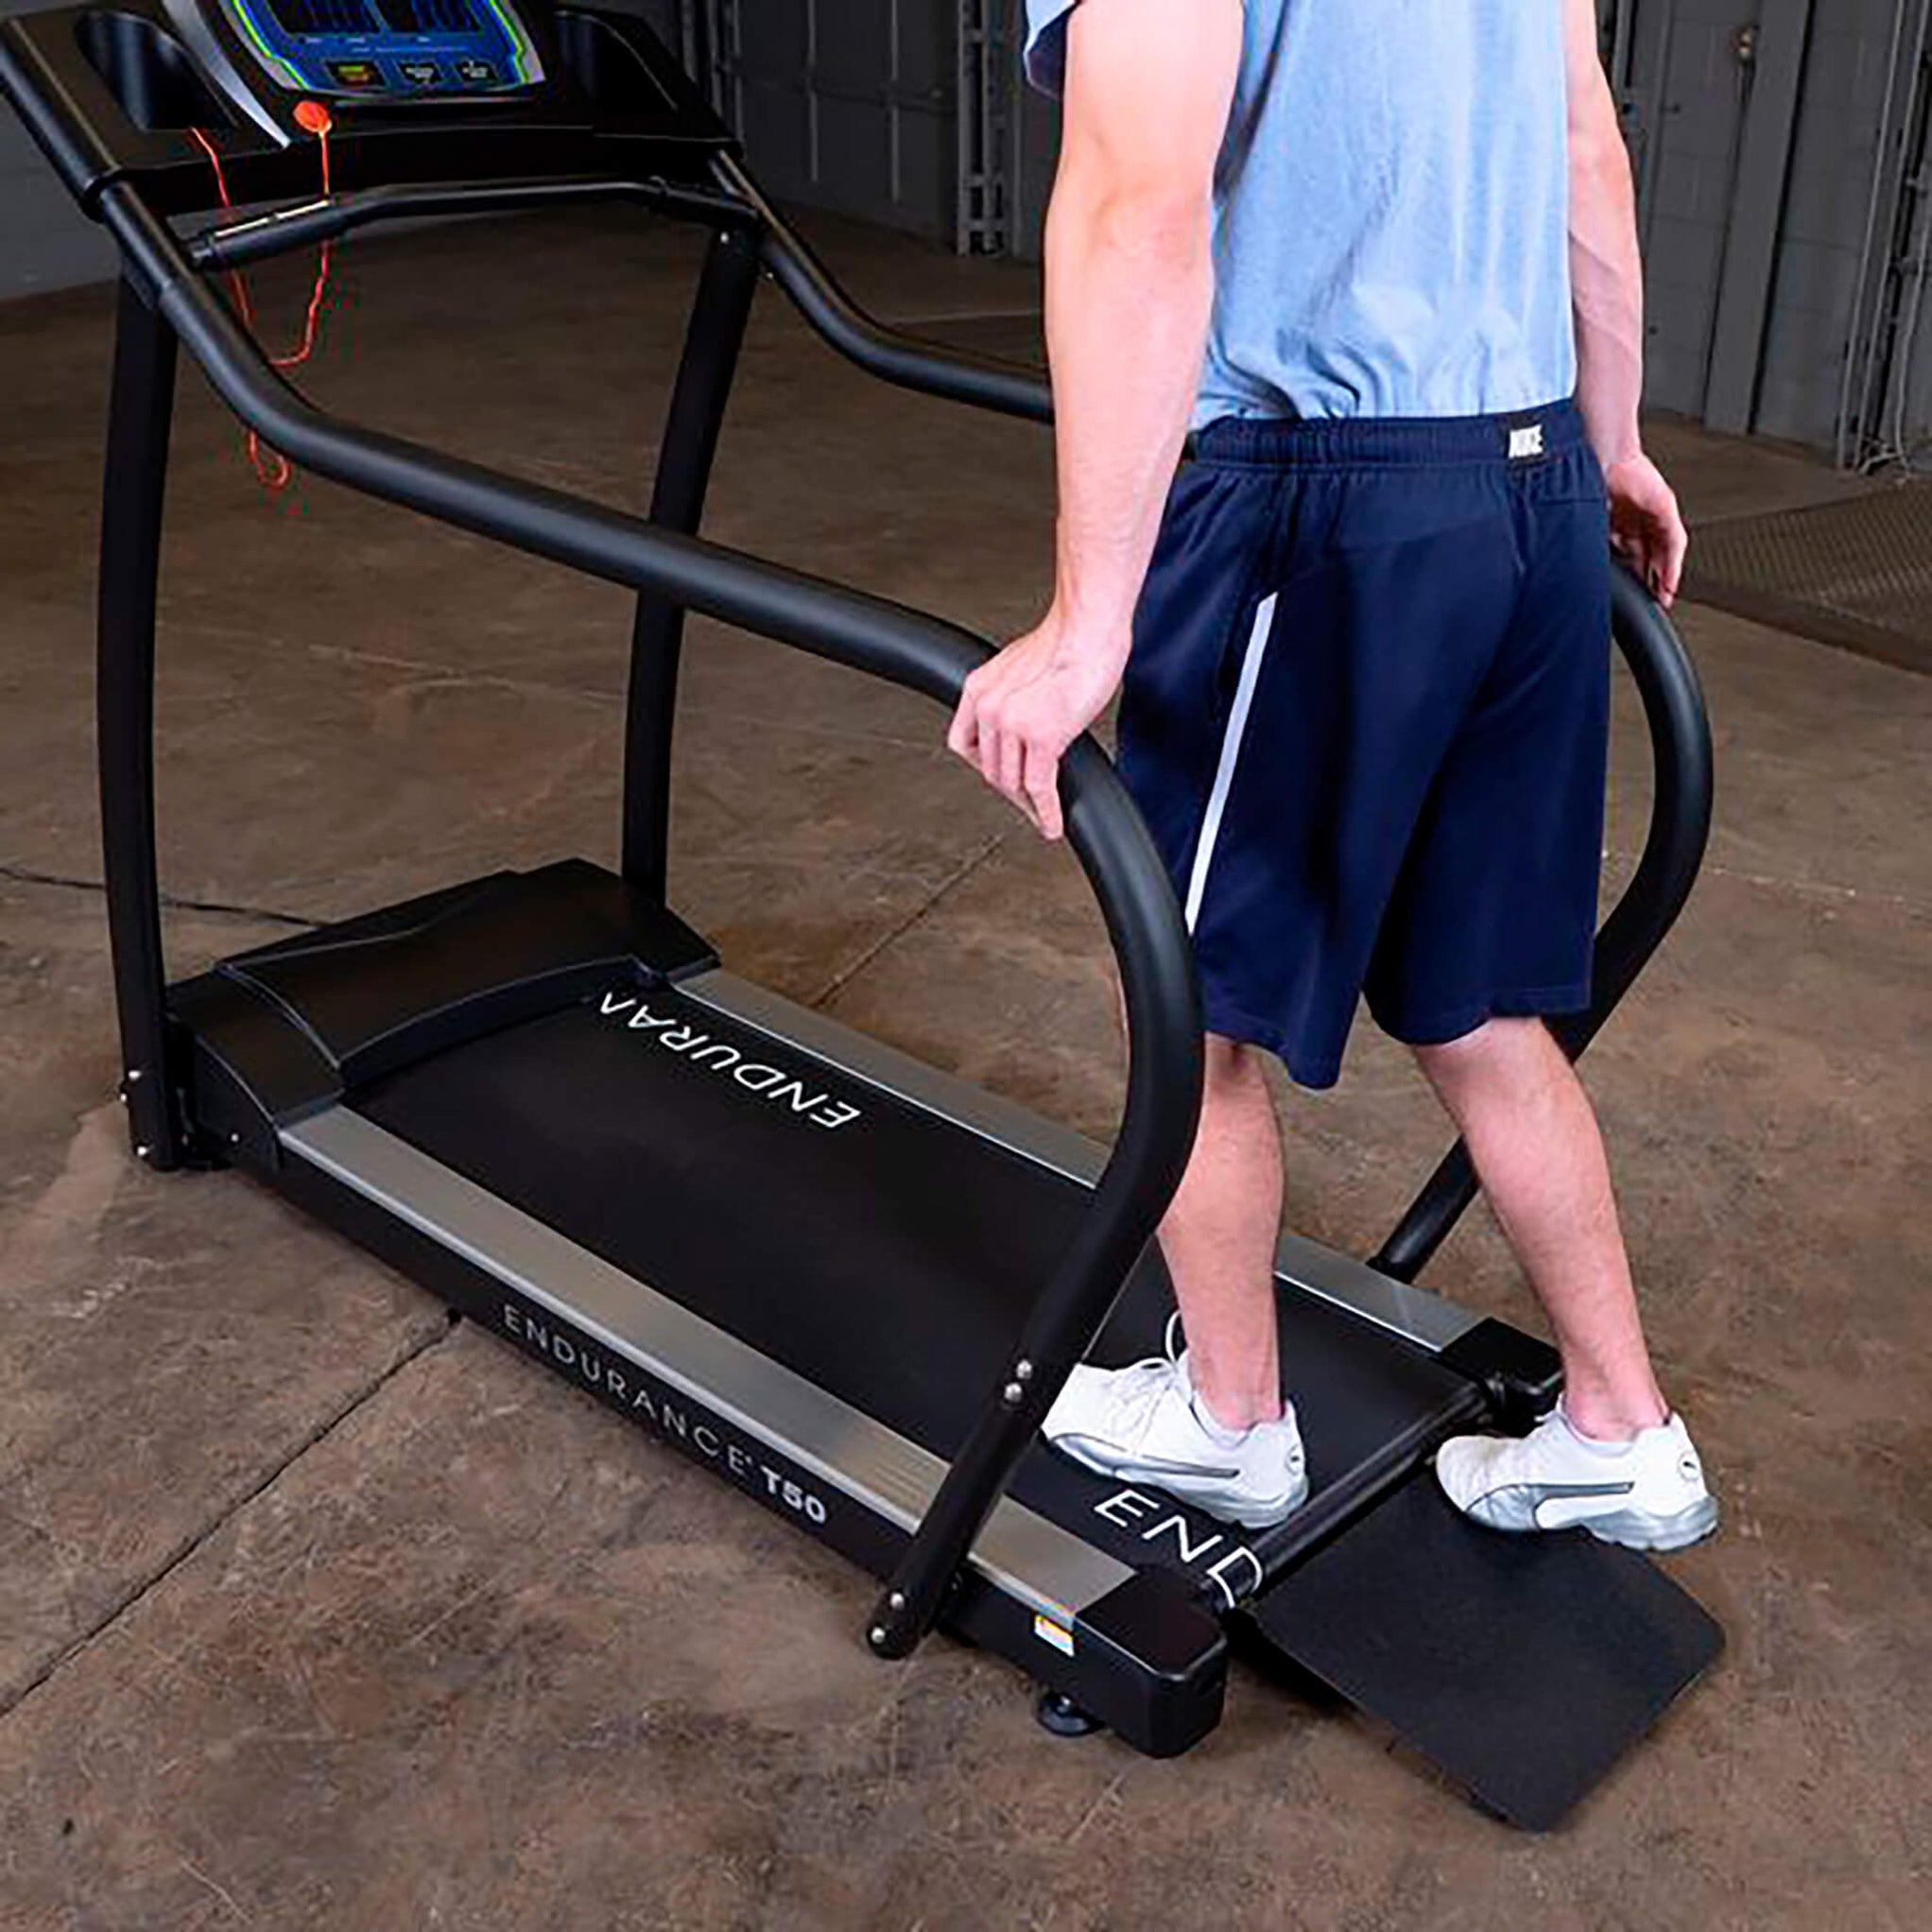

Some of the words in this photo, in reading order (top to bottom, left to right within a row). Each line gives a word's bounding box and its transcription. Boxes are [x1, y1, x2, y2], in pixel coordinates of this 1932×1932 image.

[504, 1304, 747, 1475] ENDURANCE
[760, 1464, 826, 1524] T50
[1094, 1489, 1264, 1609] END
